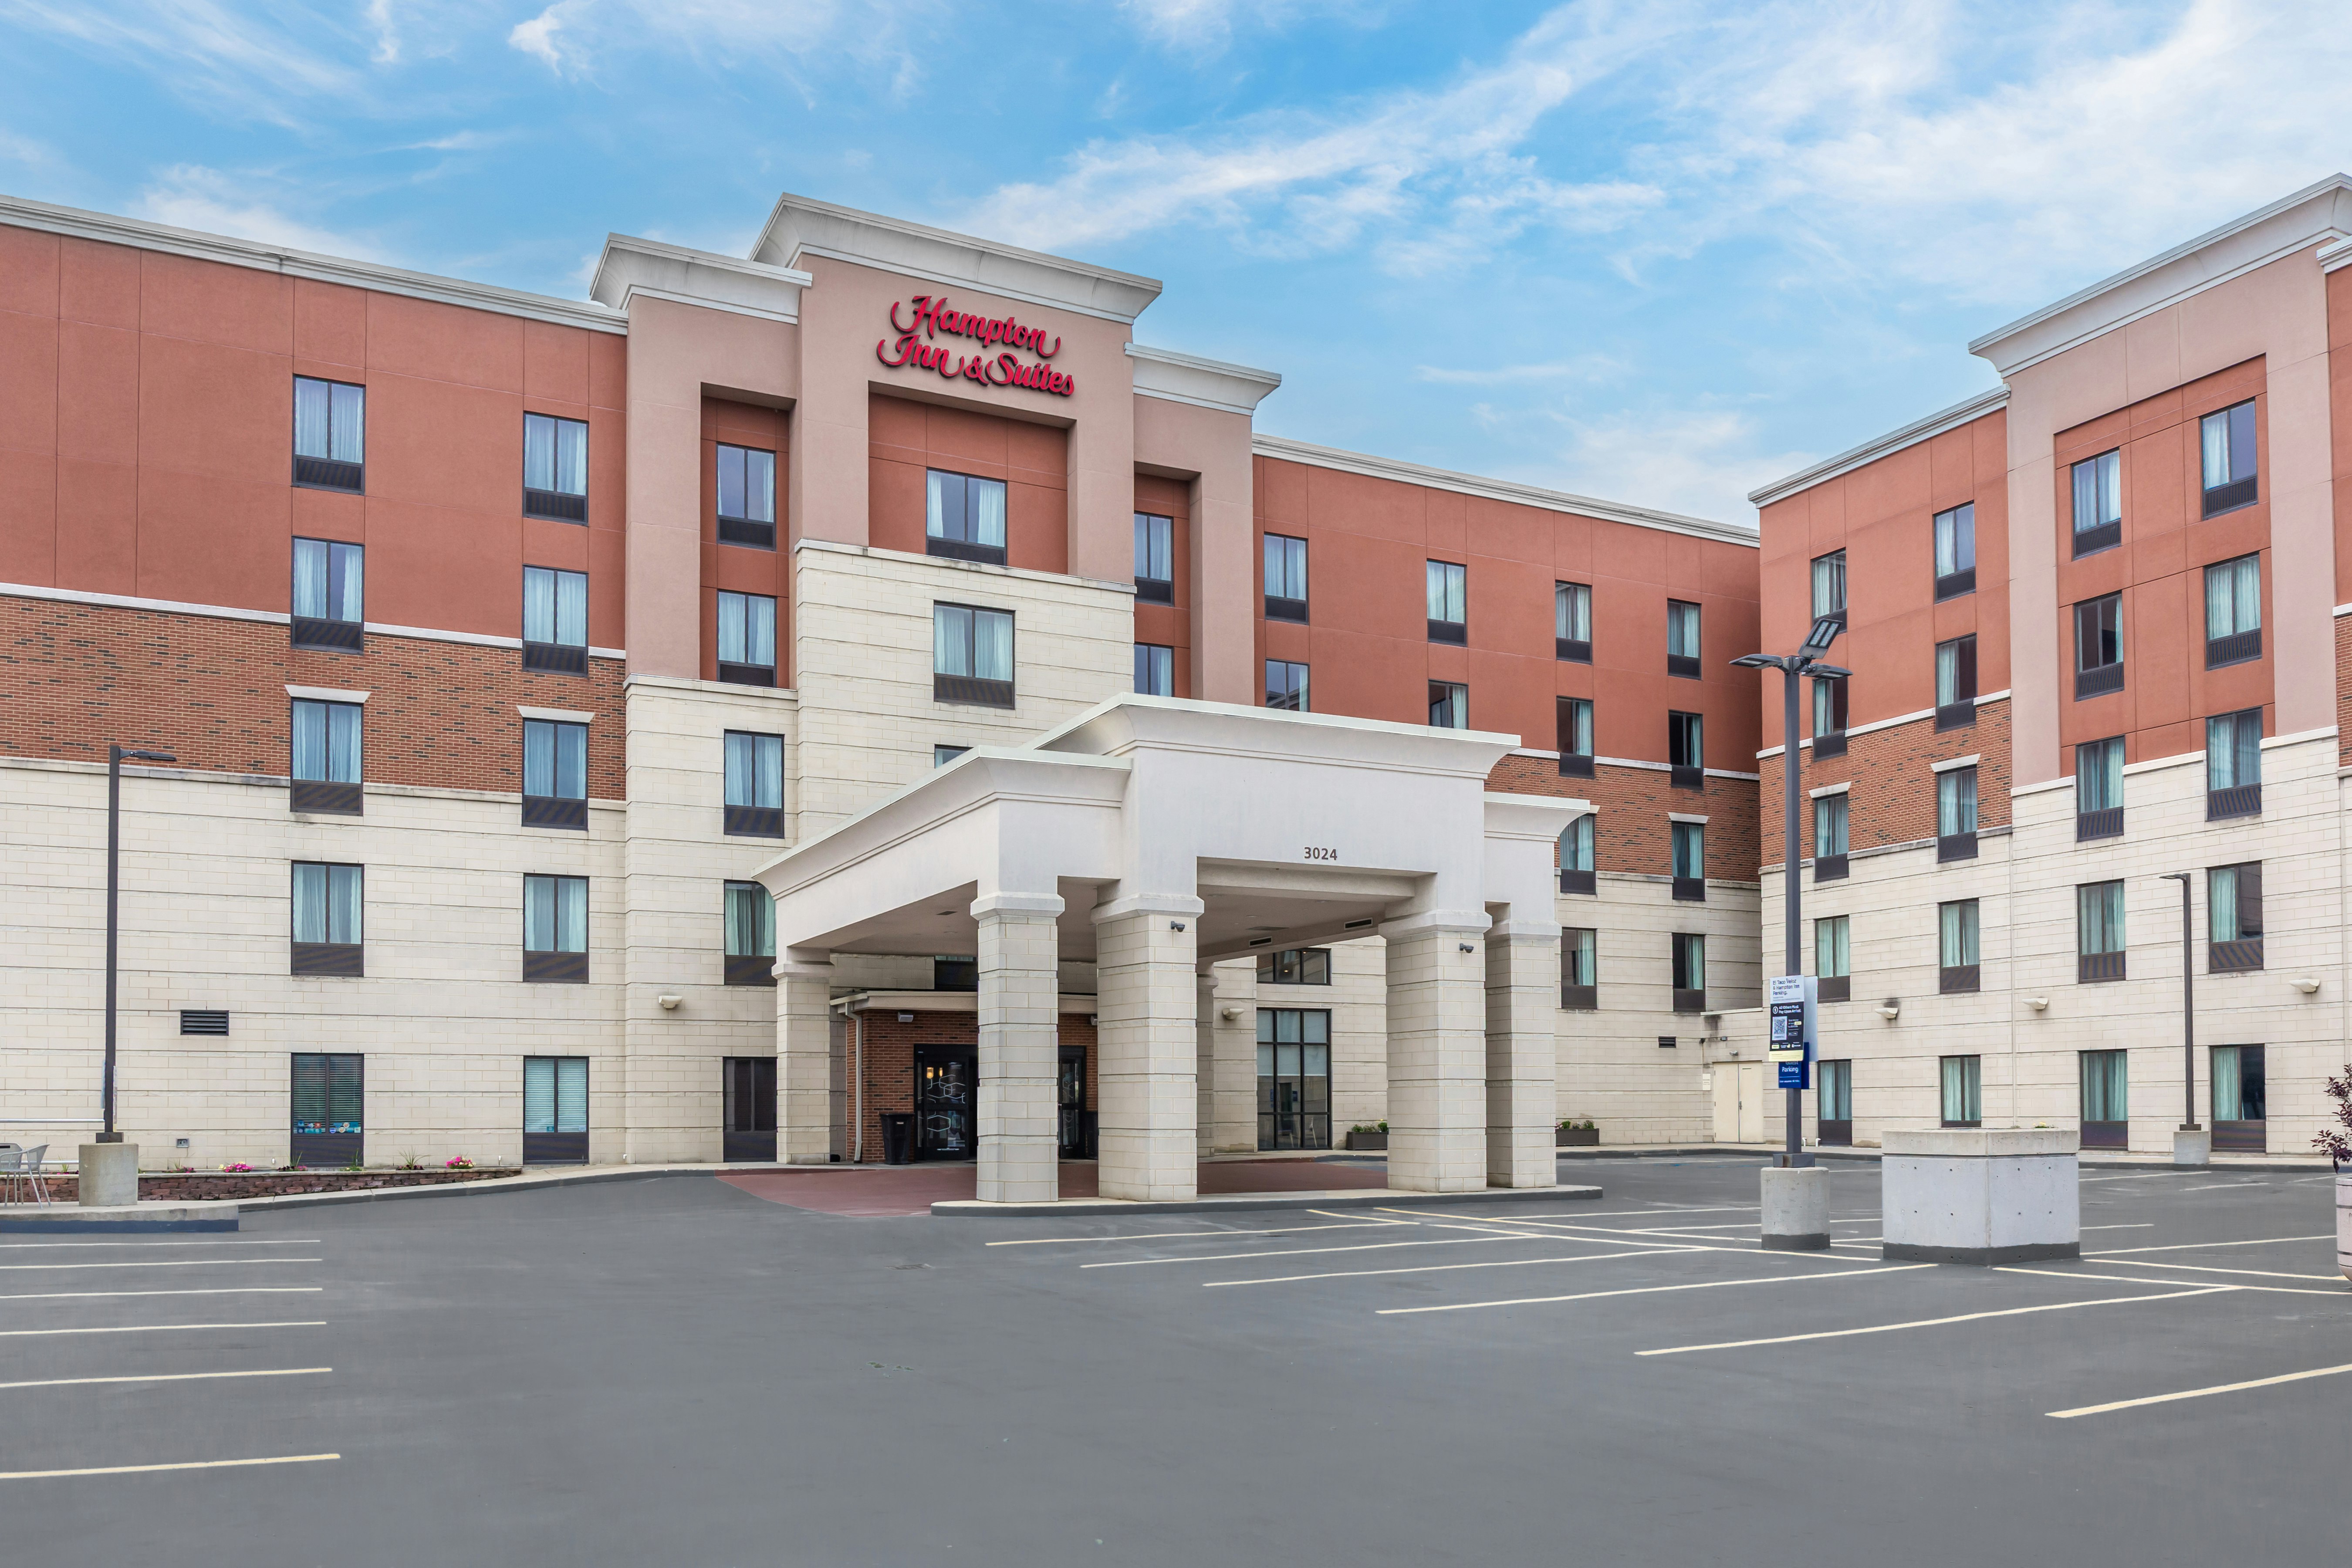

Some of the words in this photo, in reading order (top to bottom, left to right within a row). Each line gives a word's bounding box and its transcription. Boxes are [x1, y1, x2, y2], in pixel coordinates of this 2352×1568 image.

[891, 296, 1061, 358] Hampton
[877, 335, 965, 378] Inn
[963, 355, 990, 386] &
[986, 352, 1075, 395] Suites
[1304, 847, 1338, 860] 3024
